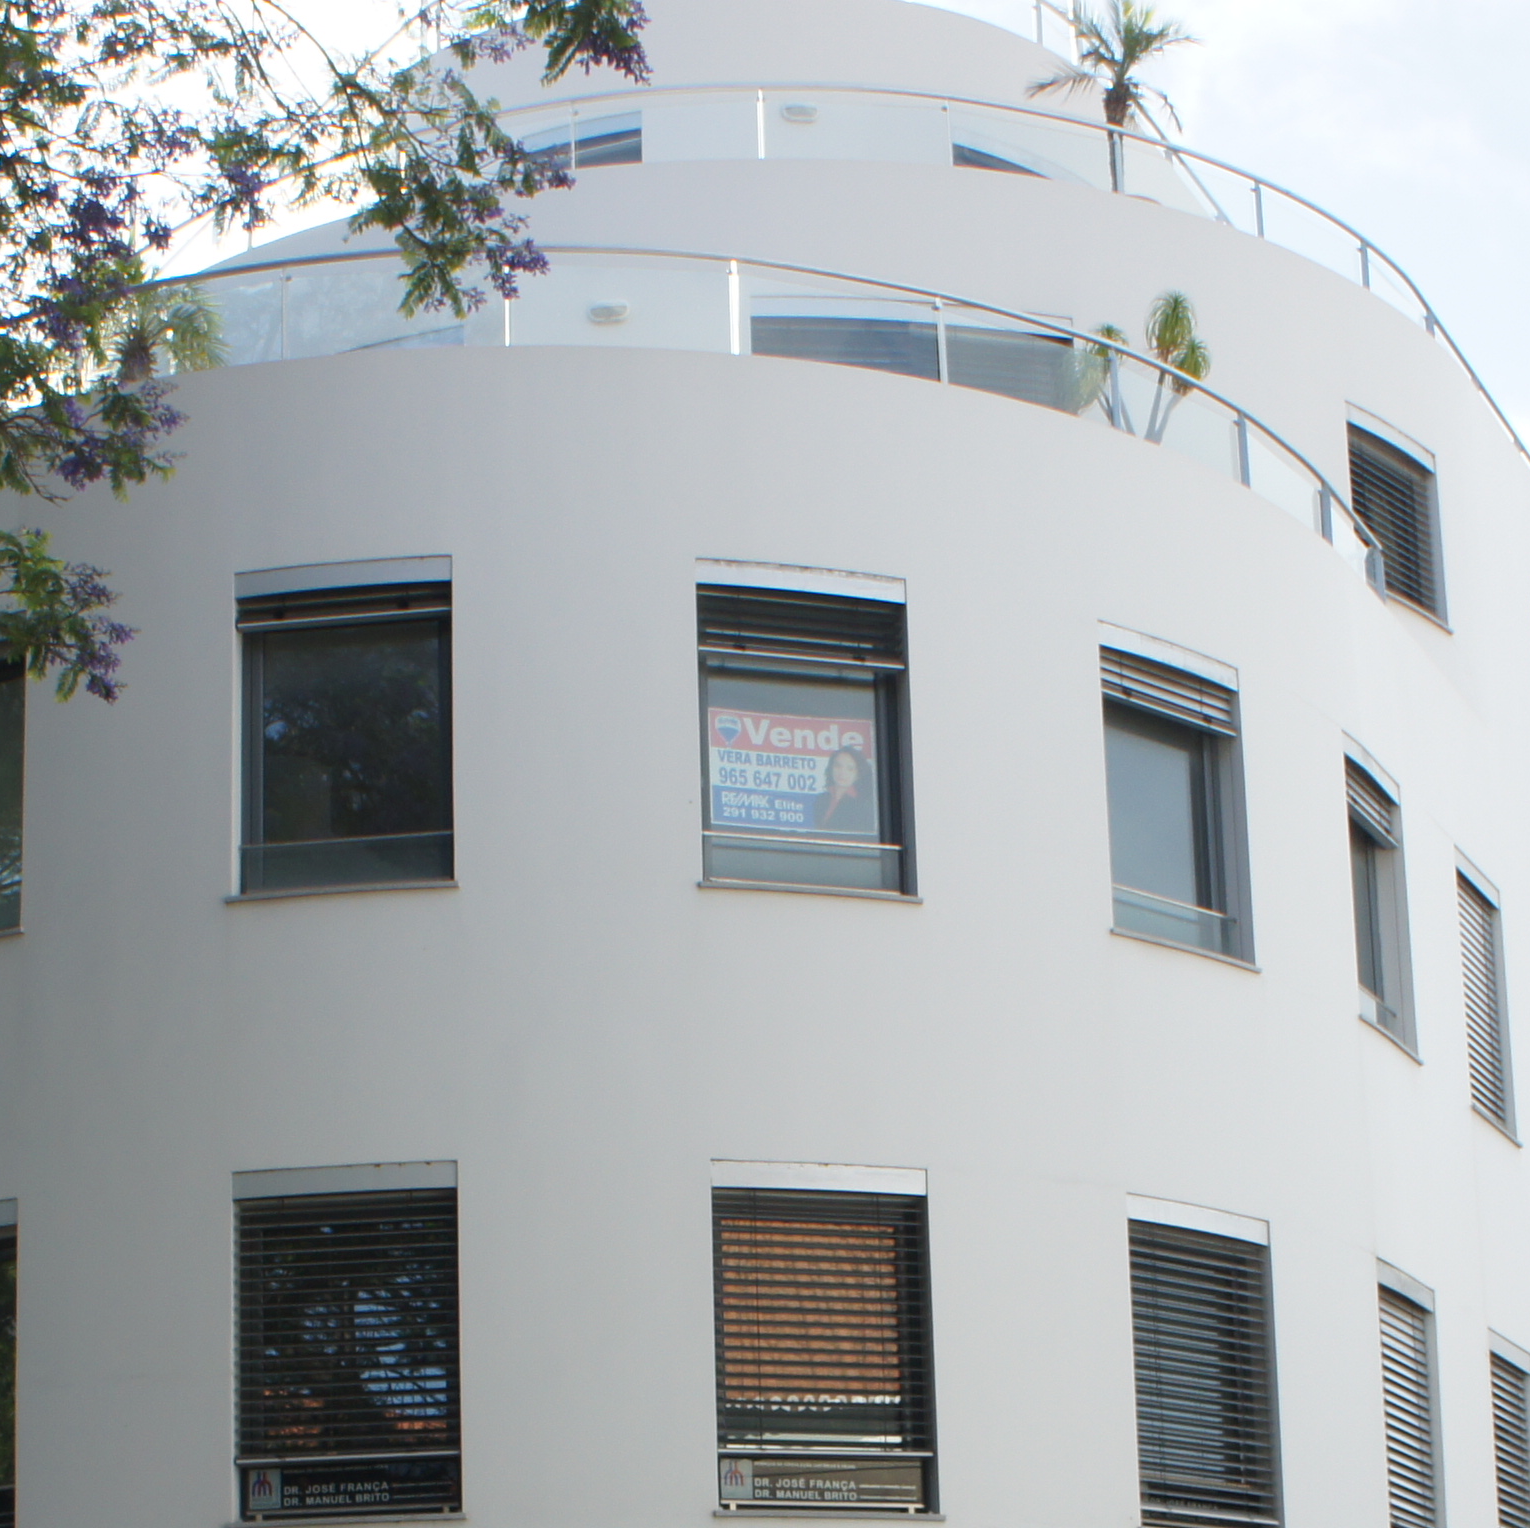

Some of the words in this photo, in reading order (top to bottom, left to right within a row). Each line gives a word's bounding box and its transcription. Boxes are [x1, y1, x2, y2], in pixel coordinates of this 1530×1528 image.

[742, 717, 864, 751] Vende
[718, 749, 751, 765] VERA
[756, 753, 816, 770] BARRETO
[719, 766, 748, 786] 965
[753, 770, 782, 788] 647
[787, 773, 816, 791] 002
[774, 799, 804, 811] Elite
[723, 806, 746, 818] 291
[751, 809, 775, 821] 932
[779, 811, 804, 823] 900
[305, 1482, 335, 1494] JOSÉ
[340, 1481, 389, 1492] FRANÇA
[754, 1478, 772, 1487] DR.
[775, 1477, 806, 1488] JOSÉ
[809, 1479, 856, 1491] FRANÇA
[306, 1494, 352, 1505] MANUEL
[355, 1492, 390, 1503] BRITO
[776, 1490, 821, 1500] MANUEL
[824, 1491, 857, 1501] BRITO
